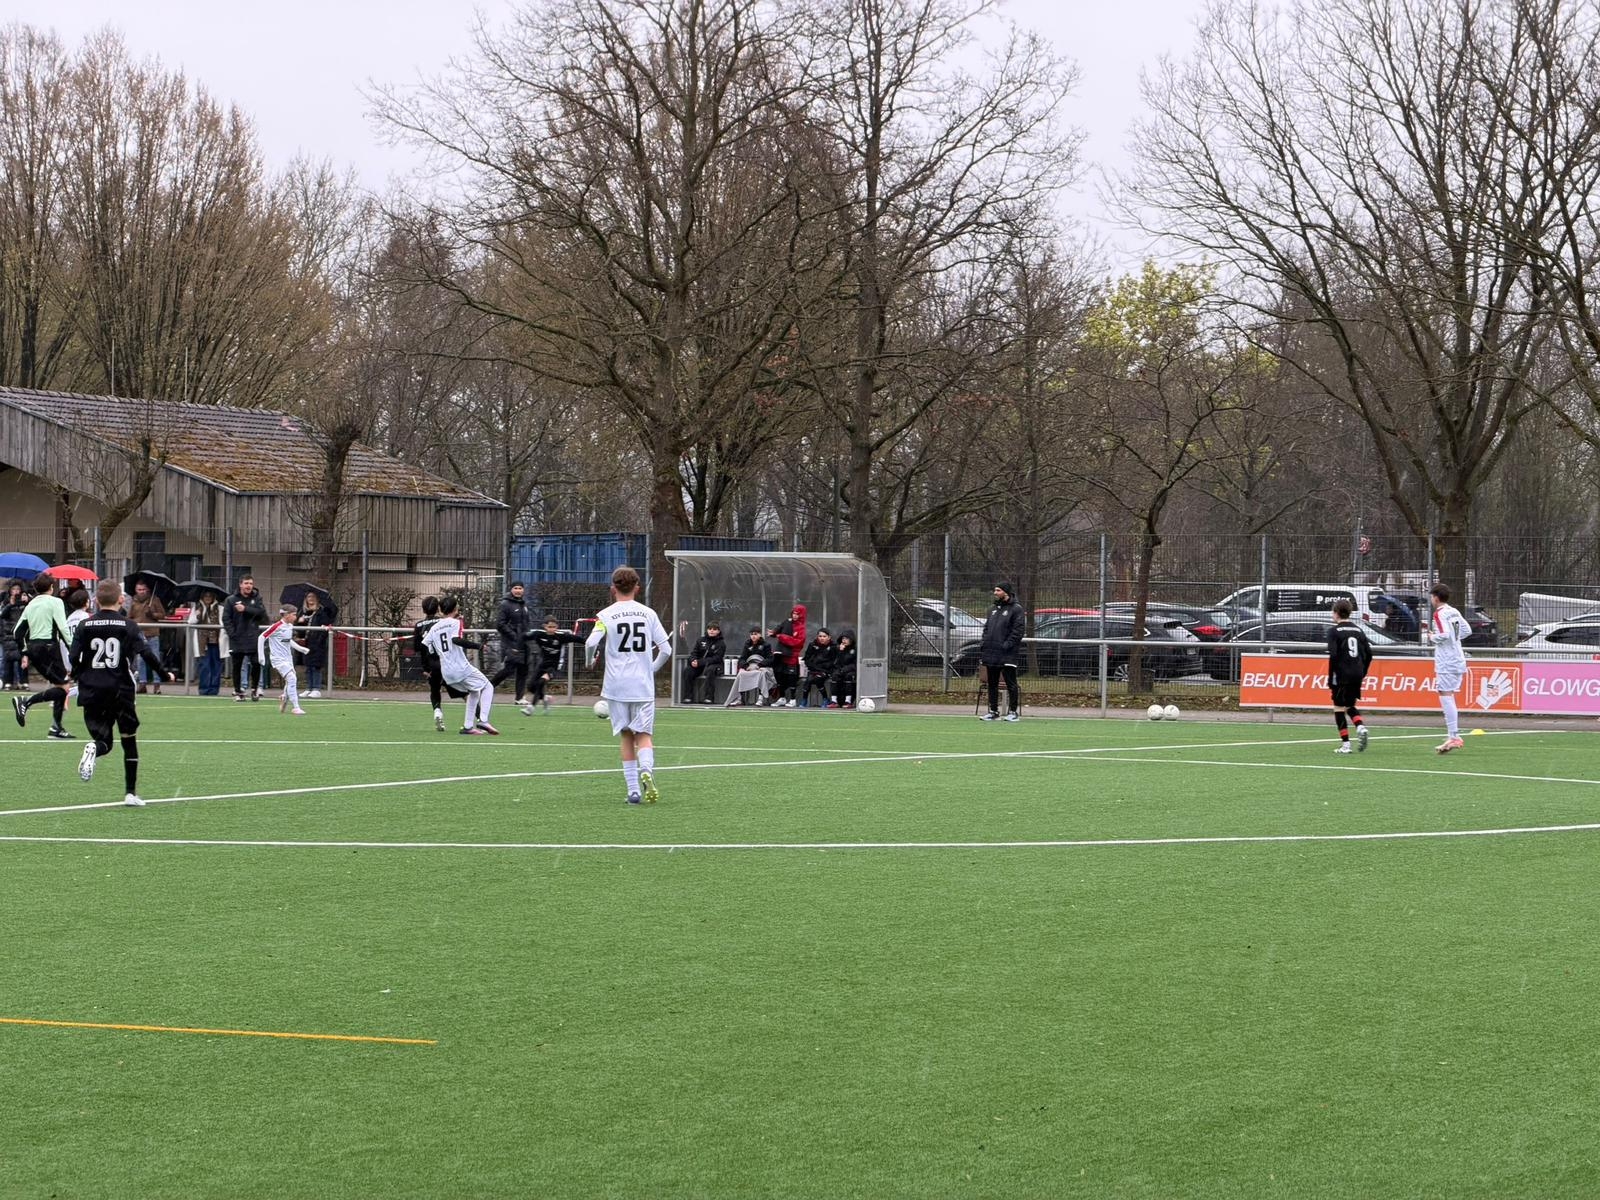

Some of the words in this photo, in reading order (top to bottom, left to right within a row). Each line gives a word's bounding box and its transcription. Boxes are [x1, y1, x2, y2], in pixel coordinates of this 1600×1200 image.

[440, 632, 449, 652] 6
[617, 622, 646, 652] 25
[1347, 636, 1359, 658] 9
[90, 637, 120, 669] 29
[1242, 673, 1310, 689] BEAUTY
[1311, 674, 1378, 691] KEER
[1380, 672, 1416, 691] FÜR
[1418, 676, 1461, 693] AL
[1523, 677, 1600, 696] GLOWG
